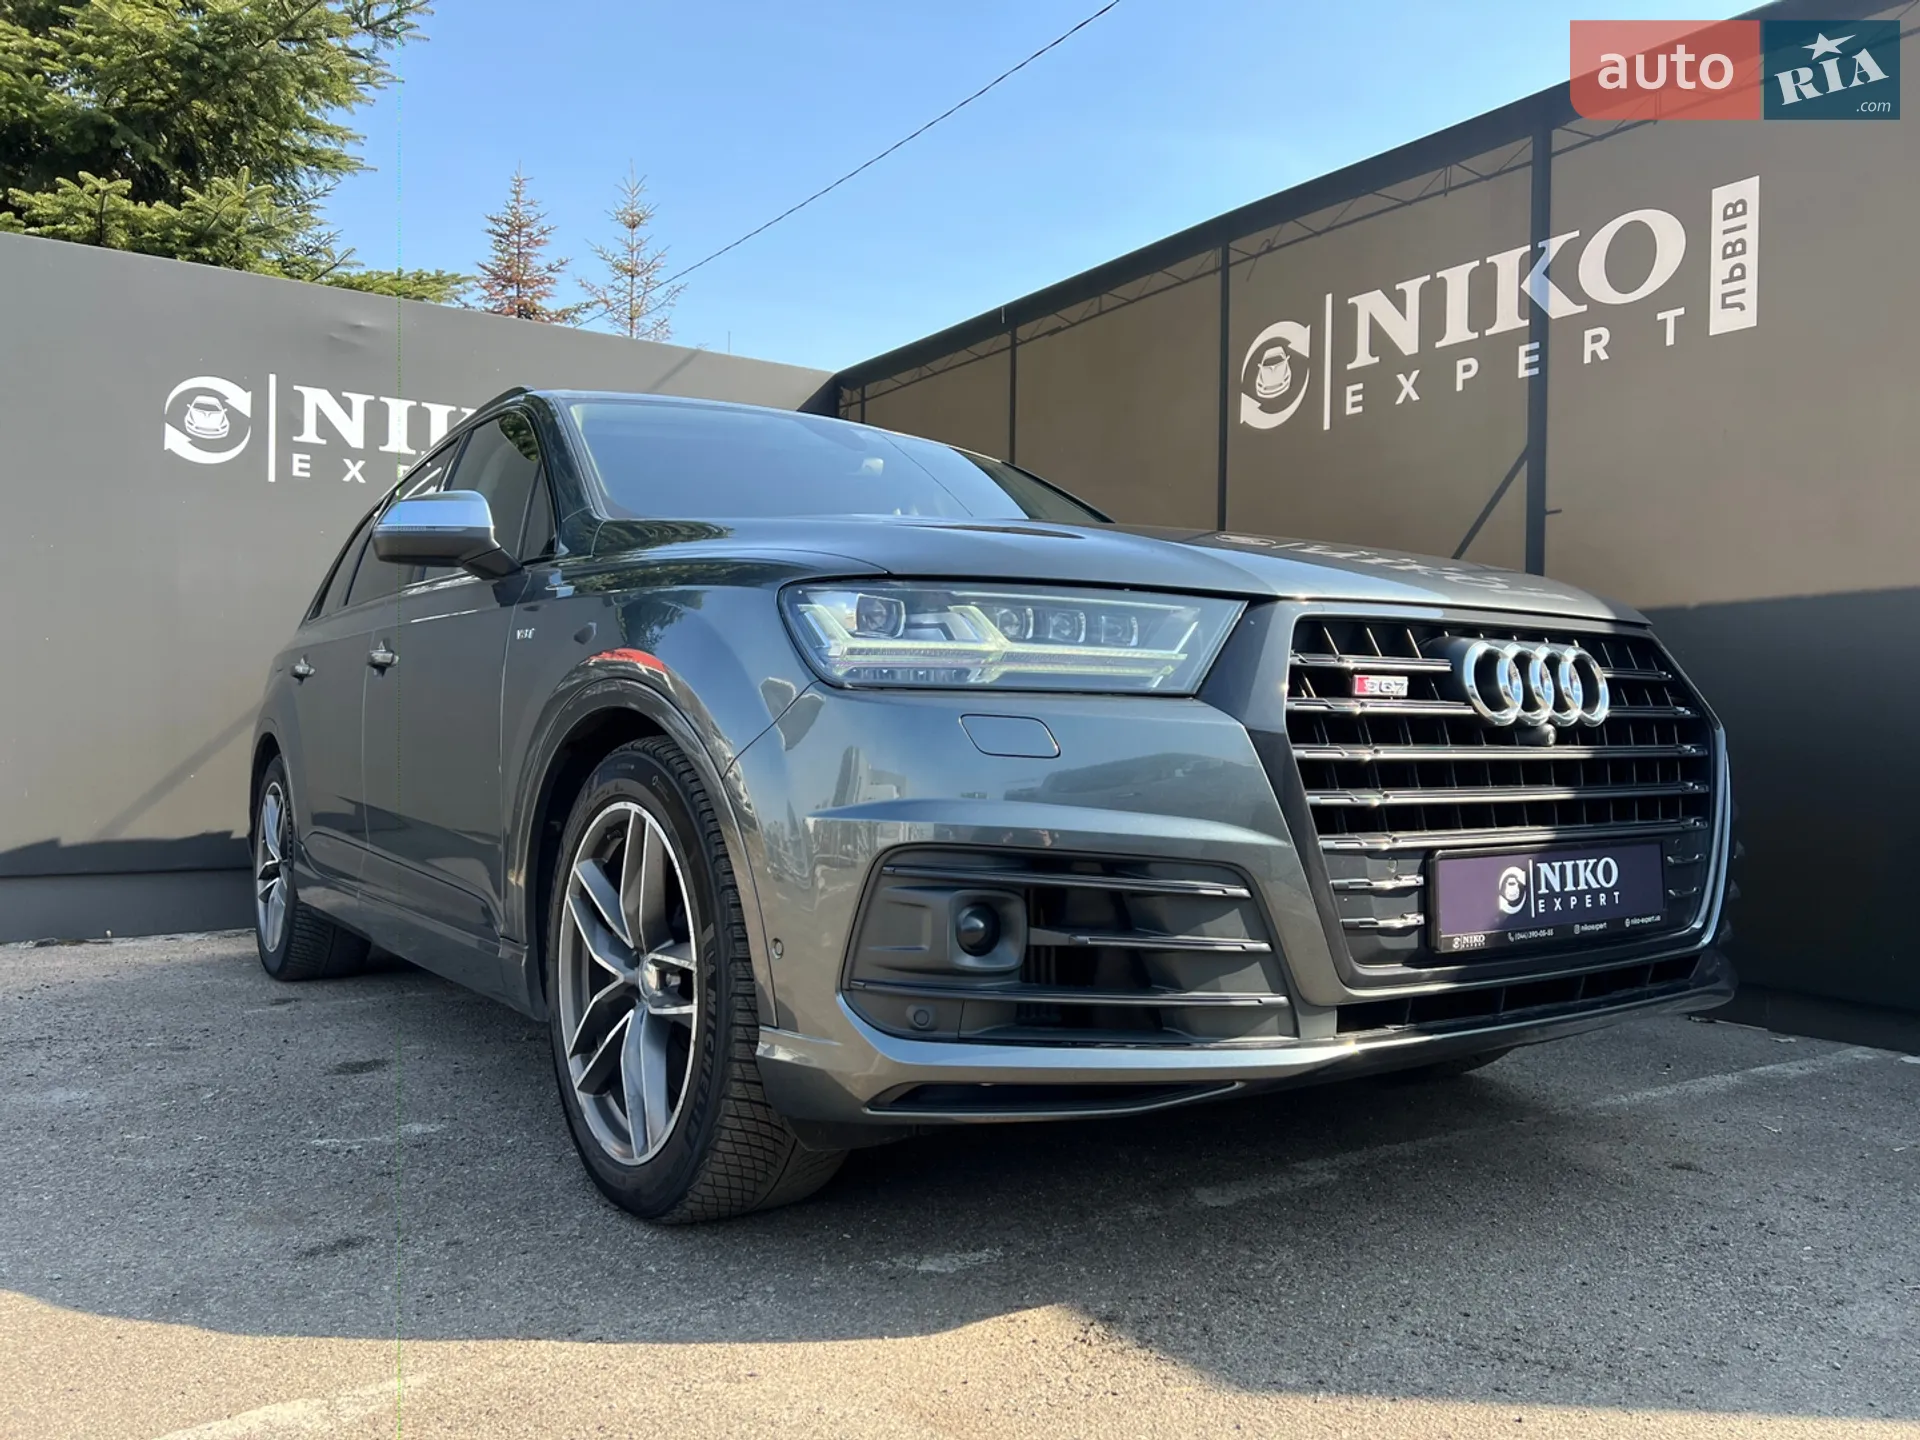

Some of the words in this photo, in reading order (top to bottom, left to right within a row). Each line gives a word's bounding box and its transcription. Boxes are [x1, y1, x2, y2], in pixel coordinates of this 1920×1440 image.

[1346, 208, 1687, 371] NIKO
[1721, 198, 1748, 313] ЛЬВІВ
[1345, 306, 1686, 416] EXPERT
[1536, 857, 1619, 895] NIKO
[1538, 891, 1620, 913] EXPERT
[1462, 934, 1486, 944] NIKO
